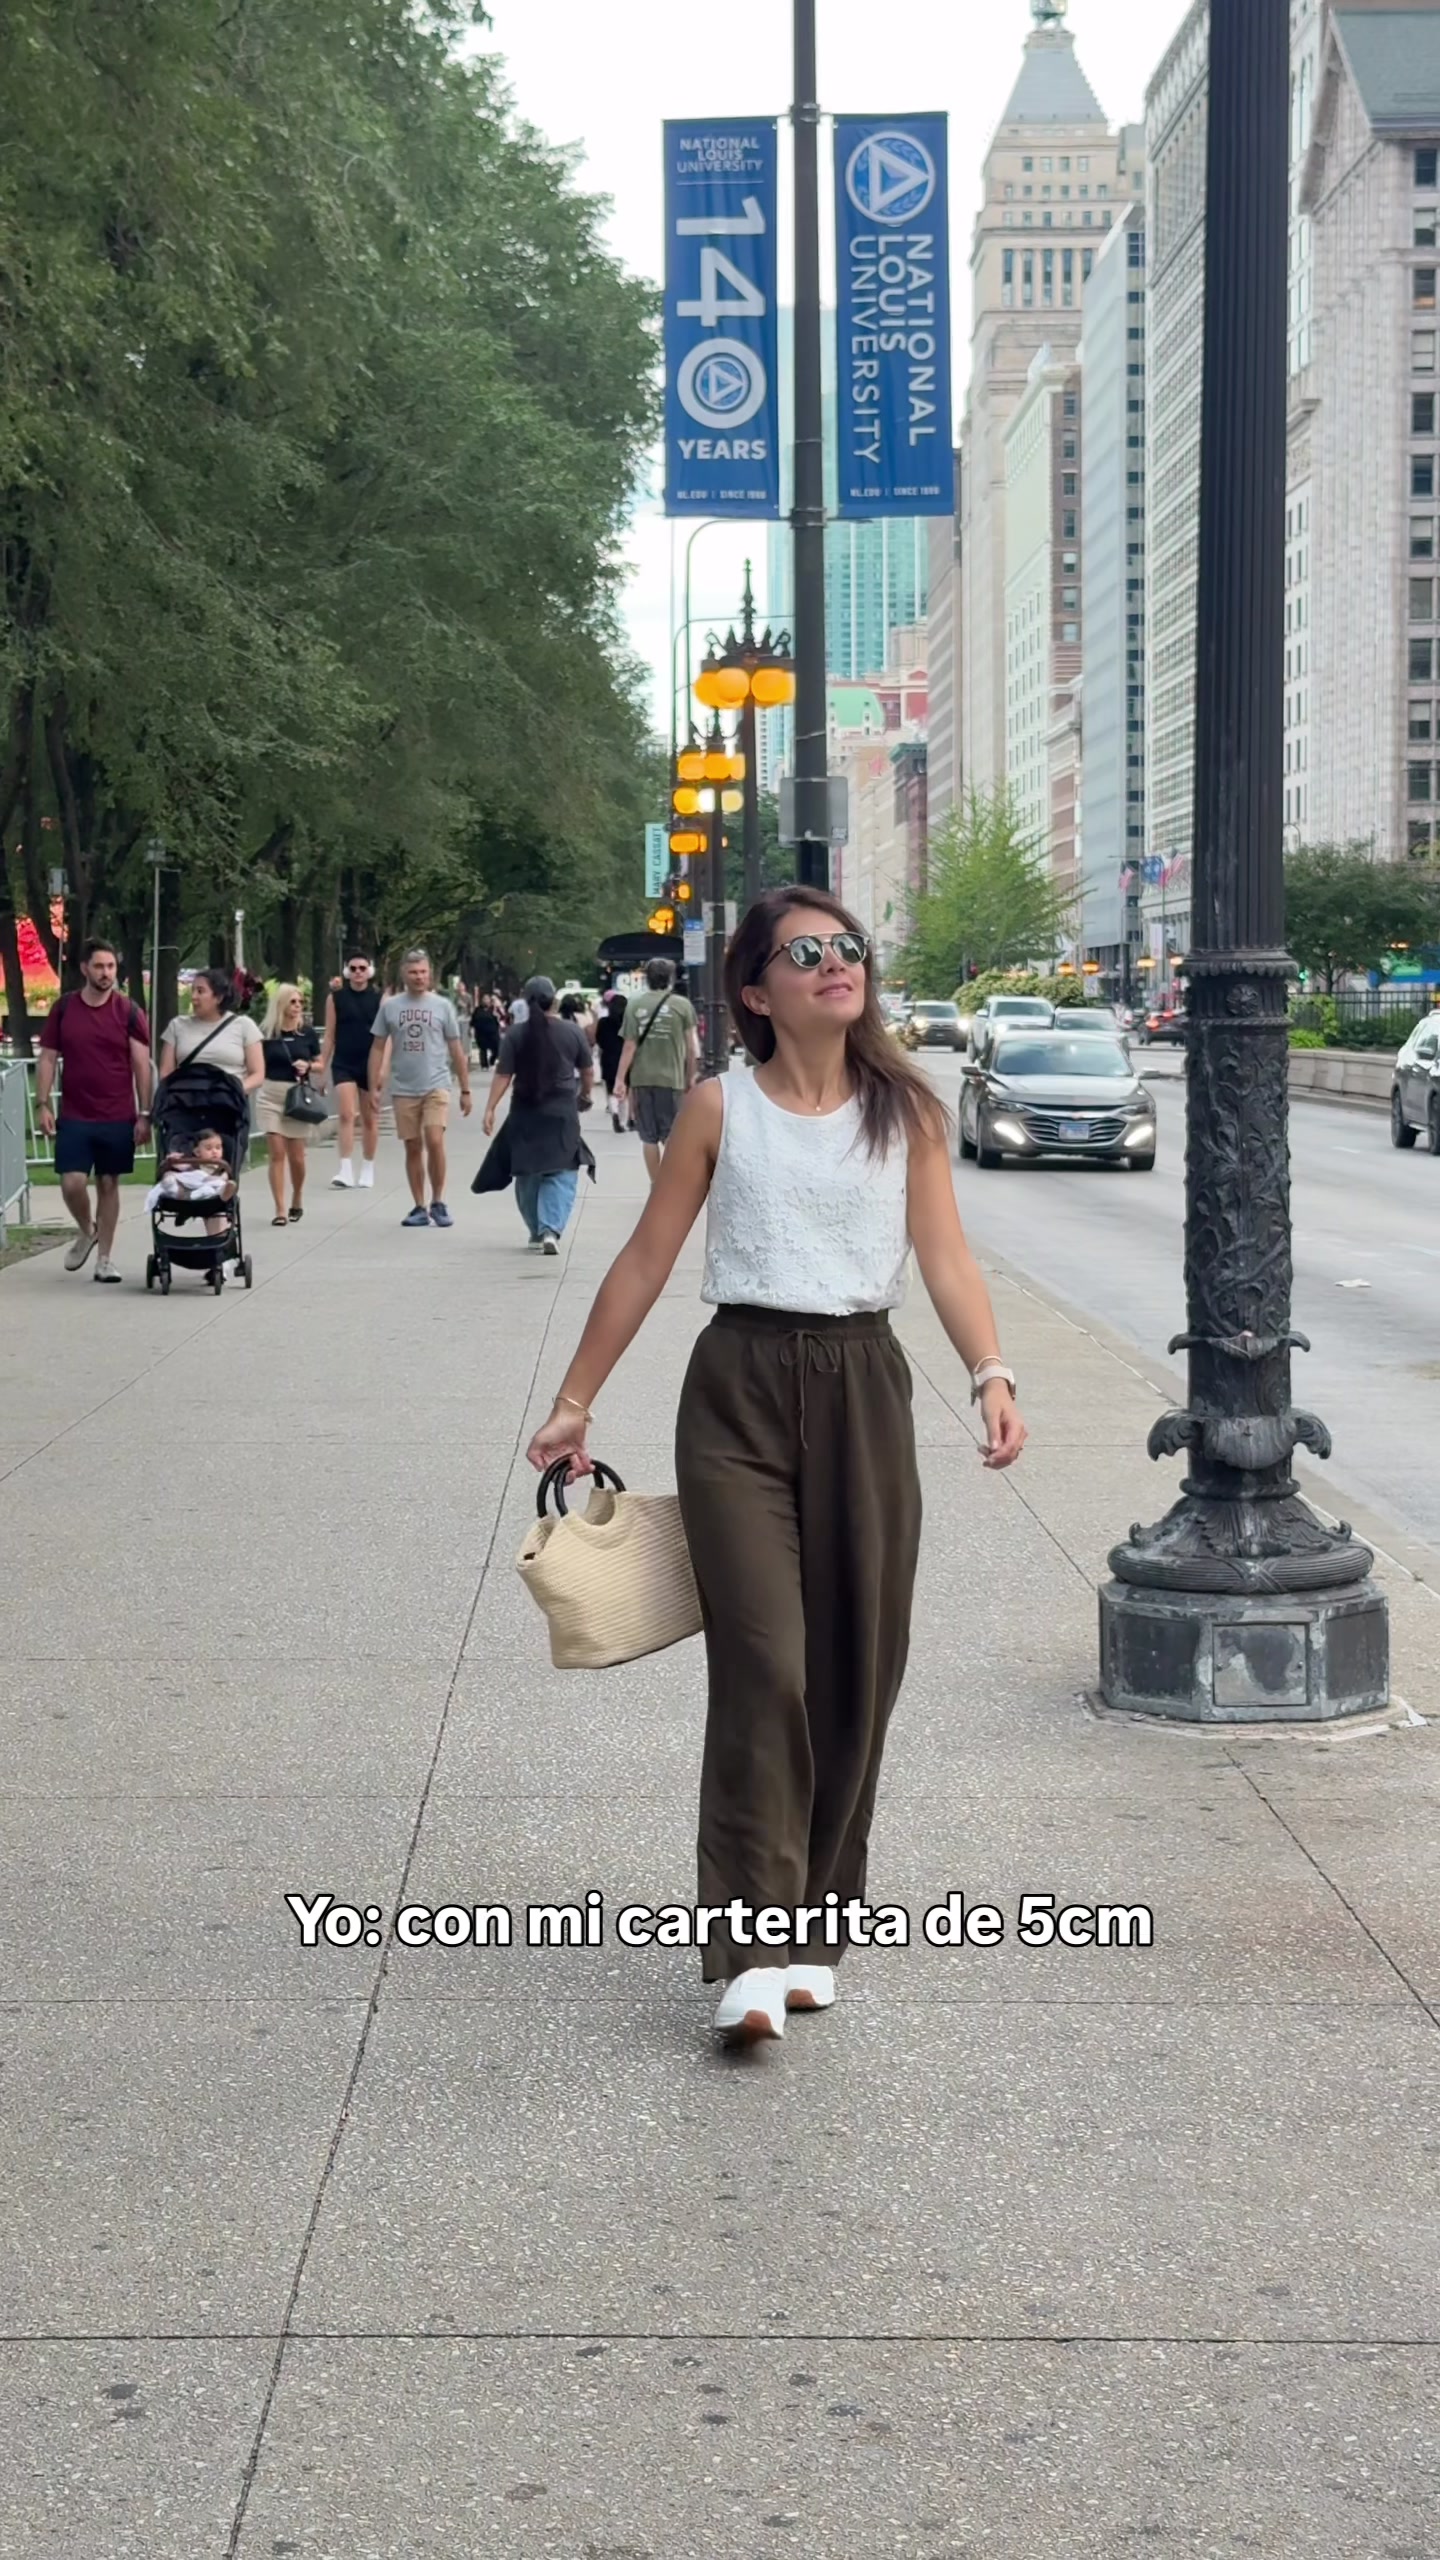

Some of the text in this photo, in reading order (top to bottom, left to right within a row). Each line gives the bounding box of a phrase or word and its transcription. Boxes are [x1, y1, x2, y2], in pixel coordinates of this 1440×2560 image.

[679, 137, 760, 150] NATIONAL
[697, 150, 744, 160] LOUIS
[676, 160, 764, 173] UNIVERSITY
[877, 235, 906, 353] LOUIS
[676, 196, 767, 430] 140
[849, 236, 880, 465] UNIVERSITY
[906, 234, 937, 447] NATIONAL
[677, 439, 768, 461] YEARS
[652, 870, 661, 895] MARY
[399, 1009, 432, 1027] GUCCI
[403, 1041, 425, 1052] 1921
